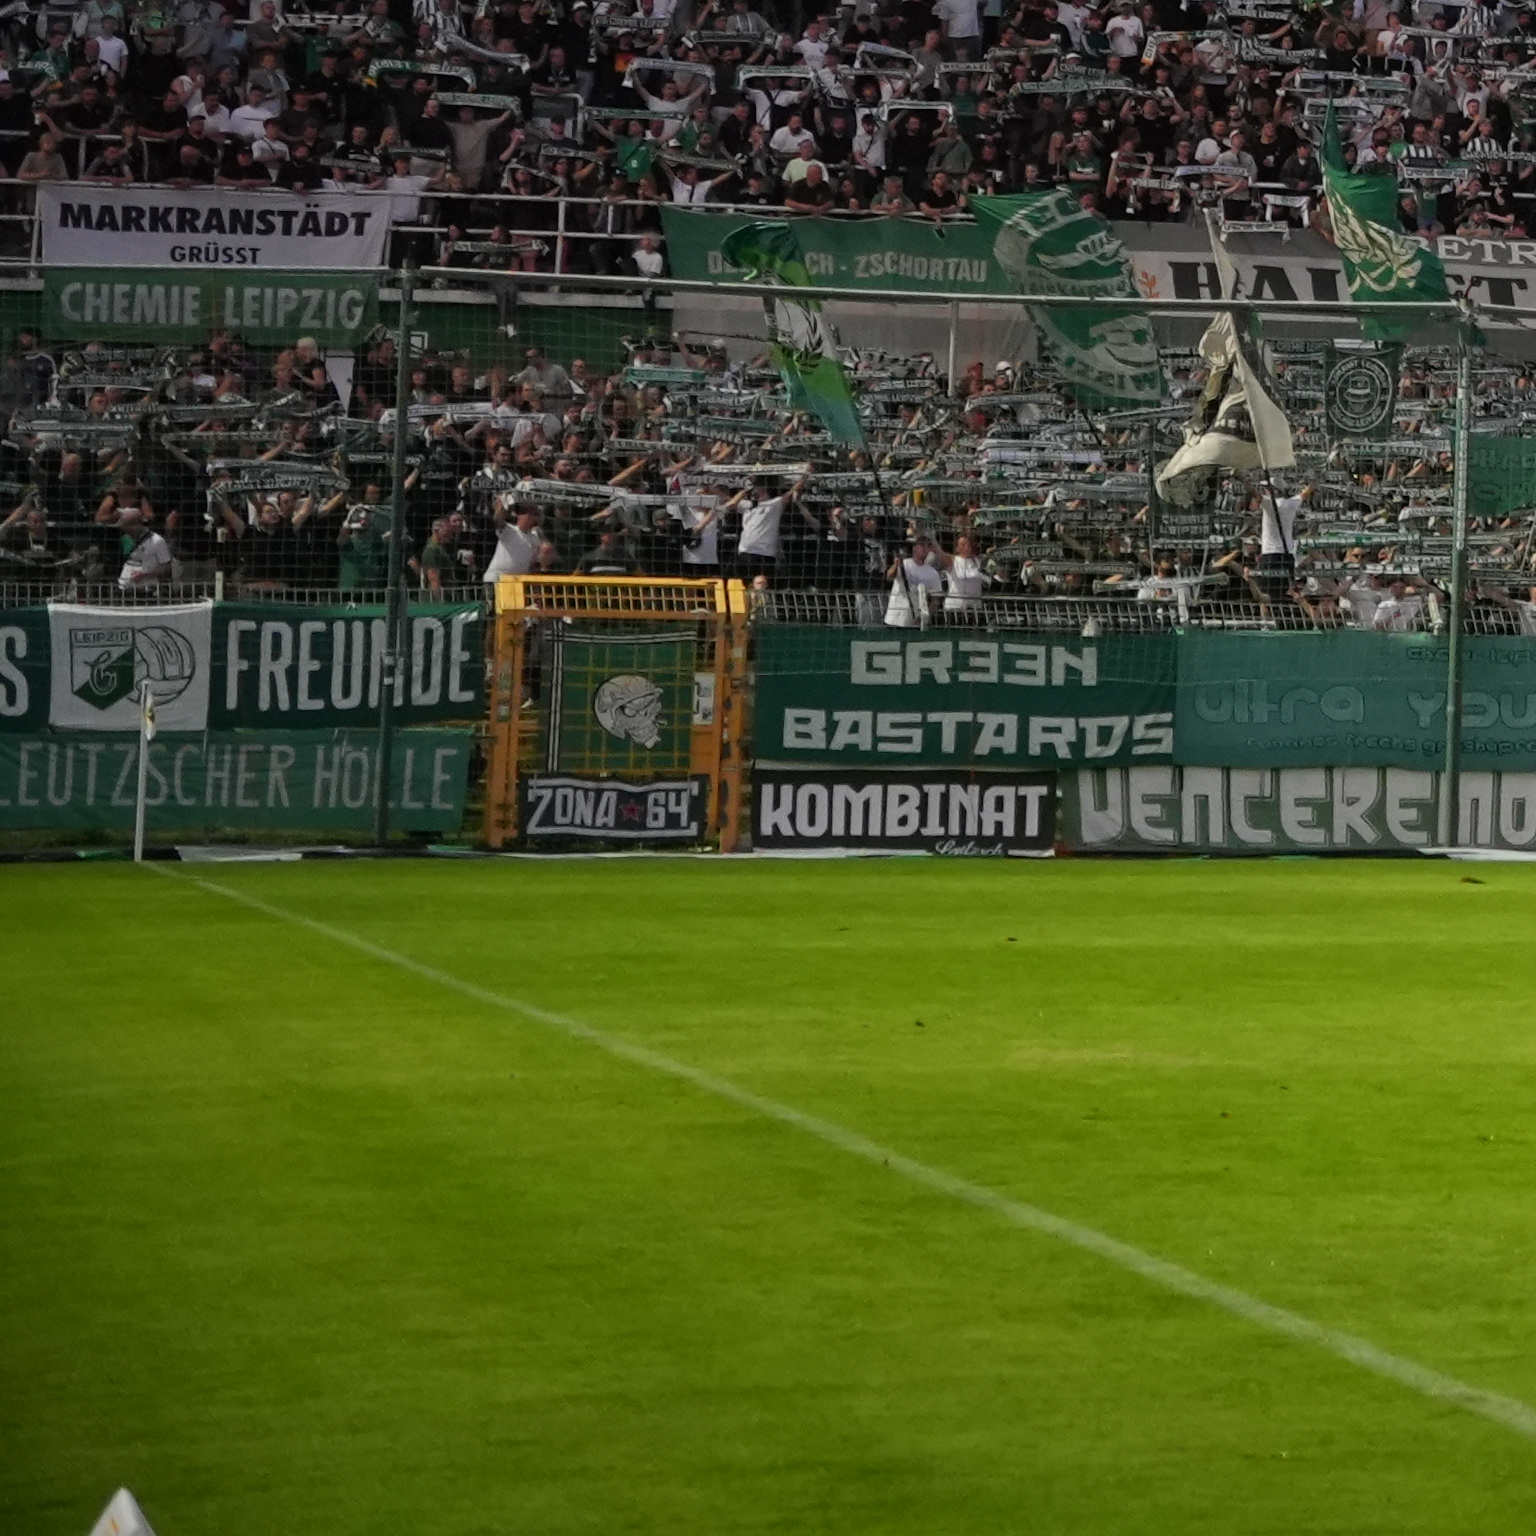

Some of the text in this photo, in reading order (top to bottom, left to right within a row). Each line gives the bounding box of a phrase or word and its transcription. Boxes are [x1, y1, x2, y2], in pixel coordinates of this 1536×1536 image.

[59, 203, 372, 238] MARKRANSTÄDT
[170, 242, 261, 265] GRÜSST
[855, 250, 988, 283] ZSCHORTAU
[59, 281, 365, 329] CHEMIE LEIPZIG
[72, 629, 129, 644] LEIPZIG
[225, 616, 476, 712] FREUNDE
[782, 707, 1175, 759] BASTARDS
[526, 787, 692, 835] ZONA 64
[759, 782, 1048, 837] KOMBINAT
